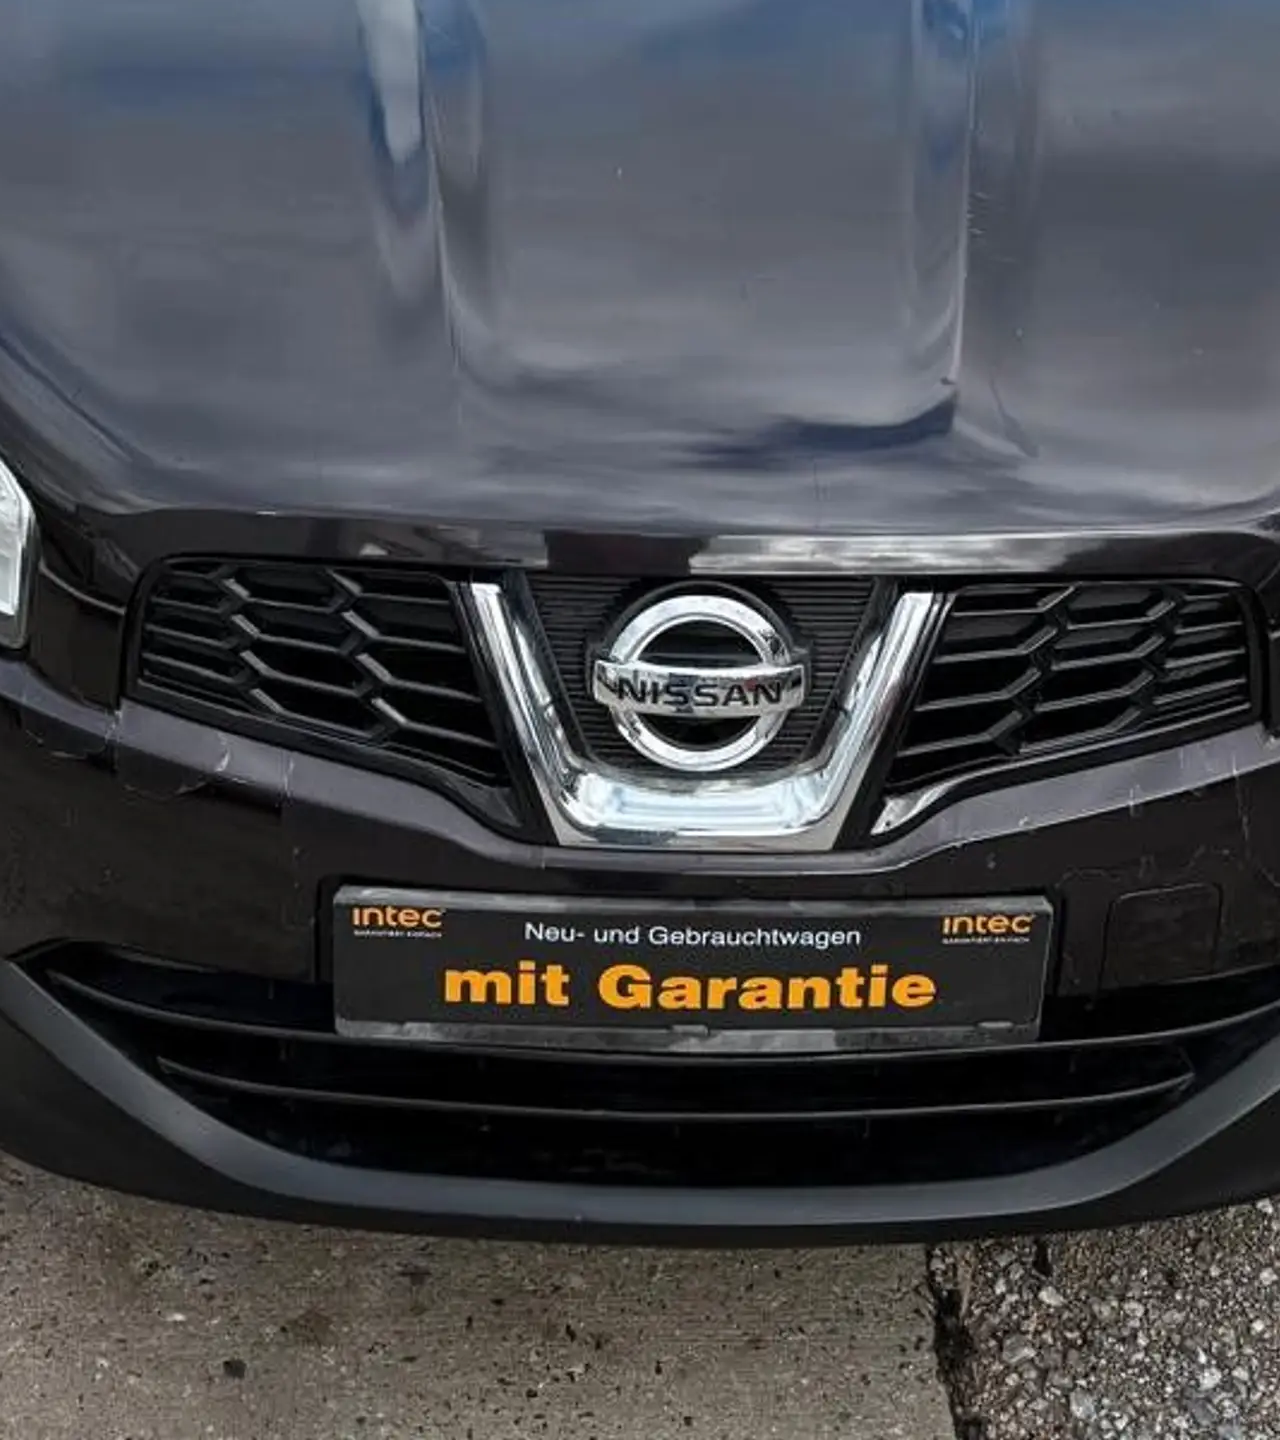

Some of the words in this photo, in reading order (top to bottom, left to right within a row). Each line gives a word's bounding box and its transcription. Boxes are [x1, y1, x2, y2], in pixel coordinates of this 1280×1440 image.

[616, 678, 782, 707] NISSAN
[352, 906, 443, 929] intec
[943, 914, 1033, 935] intec
[525, 922, 585, 943] Neu-
[595, 923, 641, 946] und
[648, 926, 861, 950] Gebrauchtwagen
[445, 960, 570, 1007] mit
[598, 964, 936, 1010] Garantie
